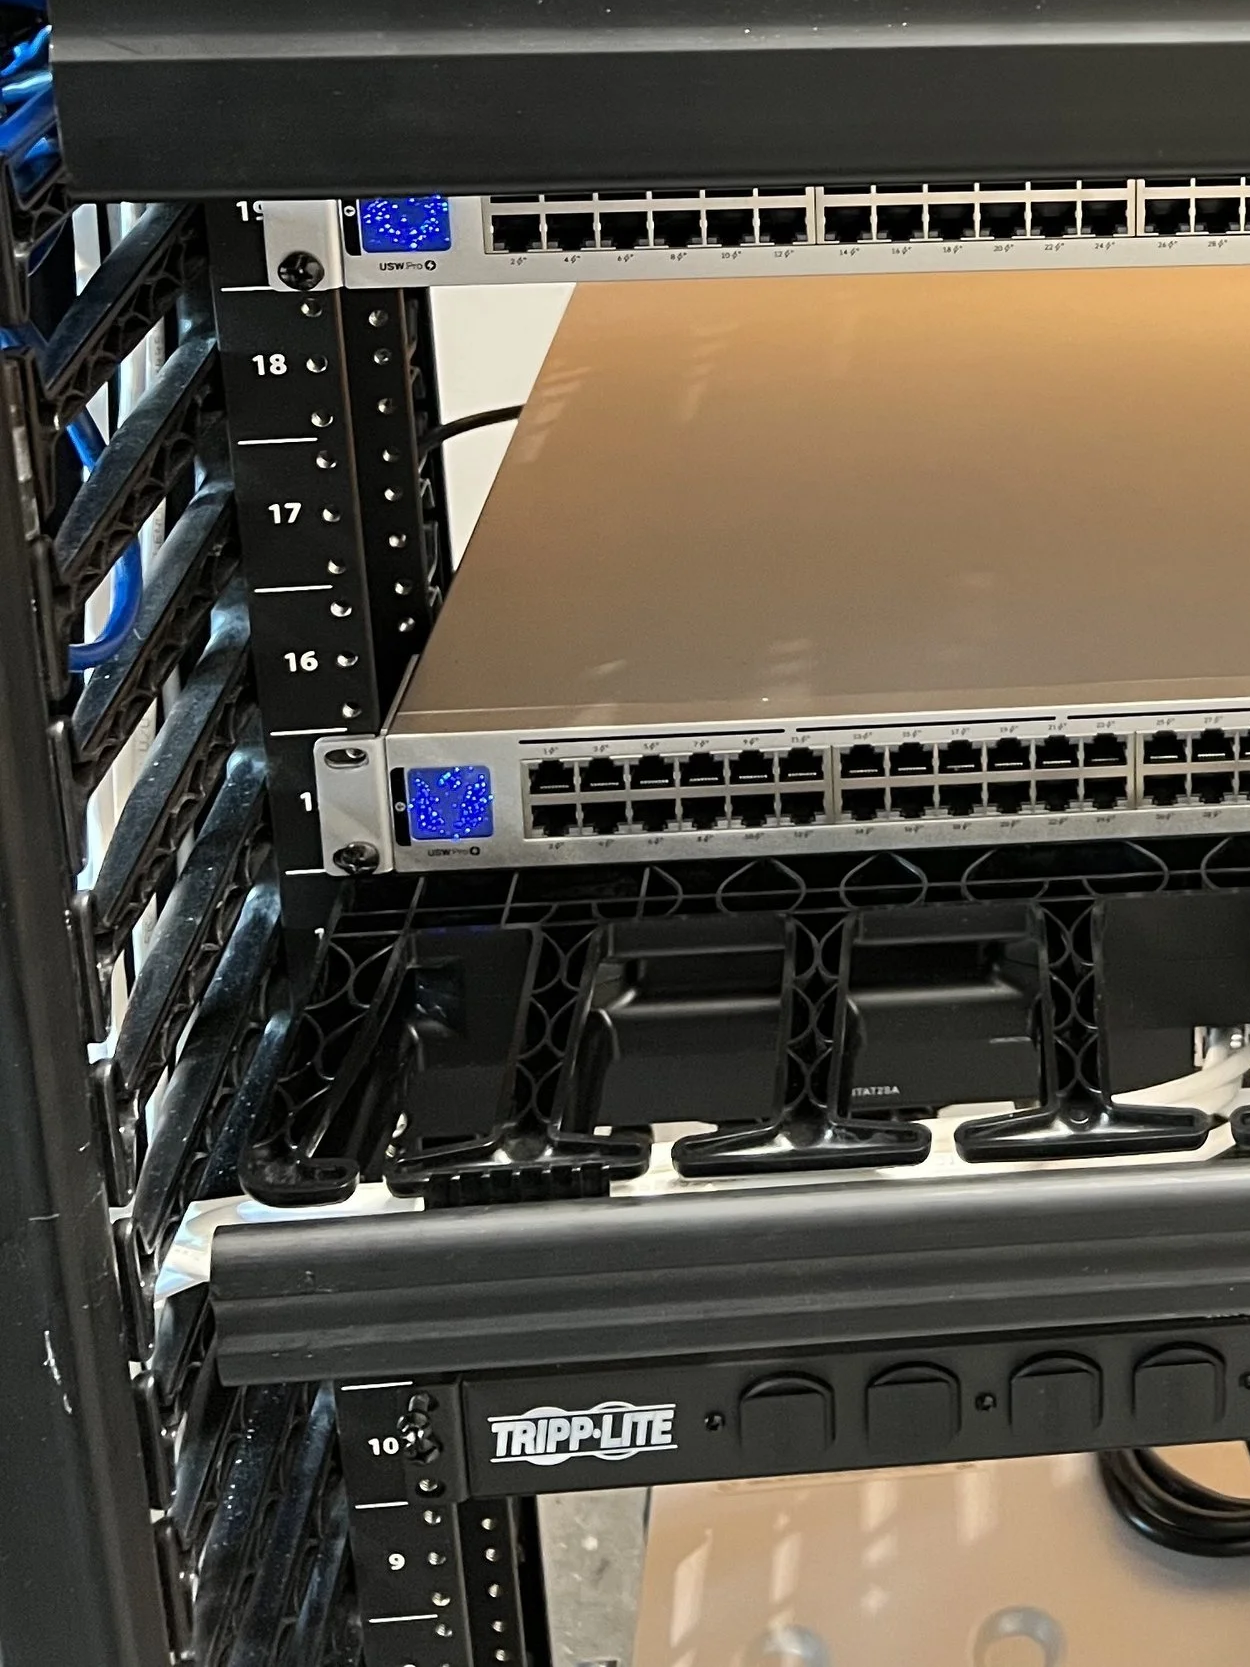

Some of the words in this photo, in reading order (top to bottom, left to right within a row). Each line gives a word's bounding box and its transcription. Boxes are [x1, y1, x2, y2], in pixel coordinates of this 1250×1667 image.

[379, 261, 404, 271] USW
[405, 261, 423, 271] Pro
[252, 353, 287, 375] 18
[268, 502, 302, 524] 17
[284, 651, 318, 672] 16
[427, 848, 451, 857] USW
[368, 1437, 400, 1456] 10
[388, 1553, 405, 1571] 9
